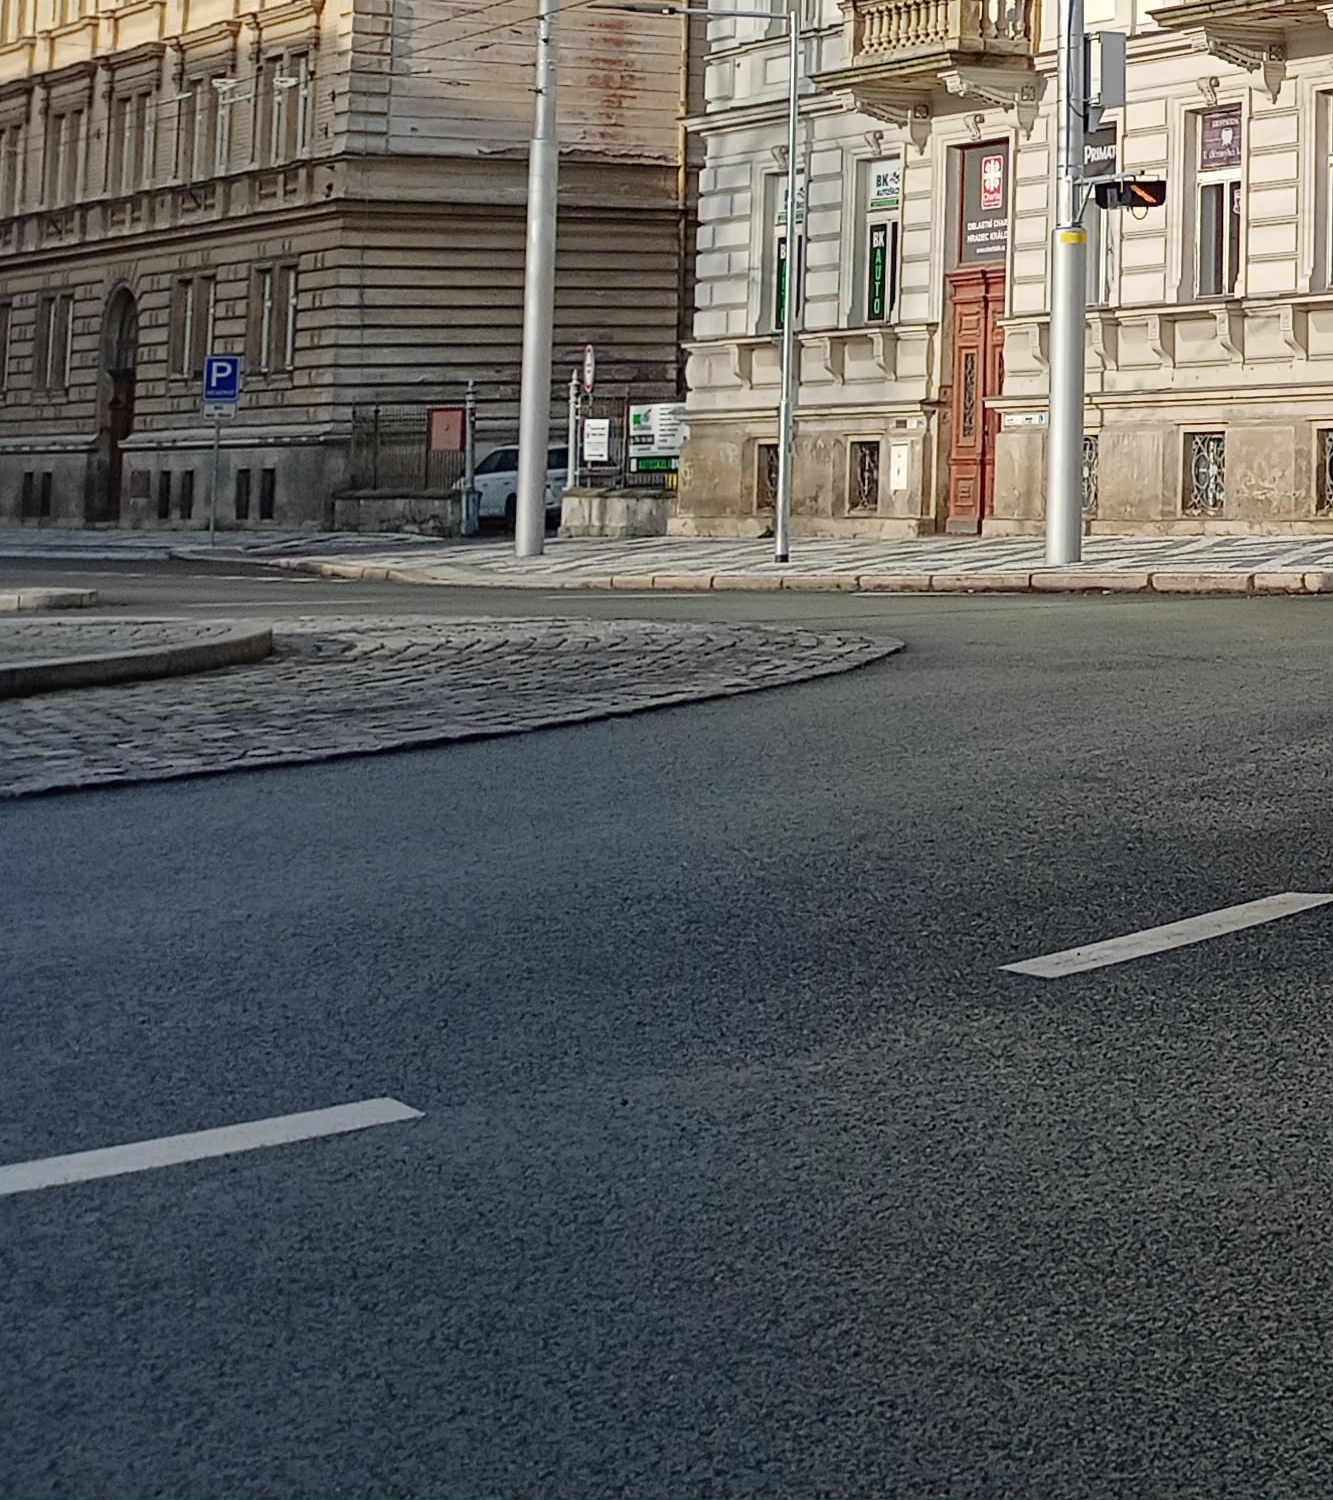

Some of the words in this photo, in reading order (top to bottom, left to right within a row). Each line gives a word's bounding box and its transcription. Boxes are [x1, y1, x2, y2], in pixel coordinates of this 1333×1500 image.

[876, 173, 889, 188] BK
[872, 231, 885, 249] BK
[873, 248, 883, 315] AUTO
[211, 361, 233, 388] P
